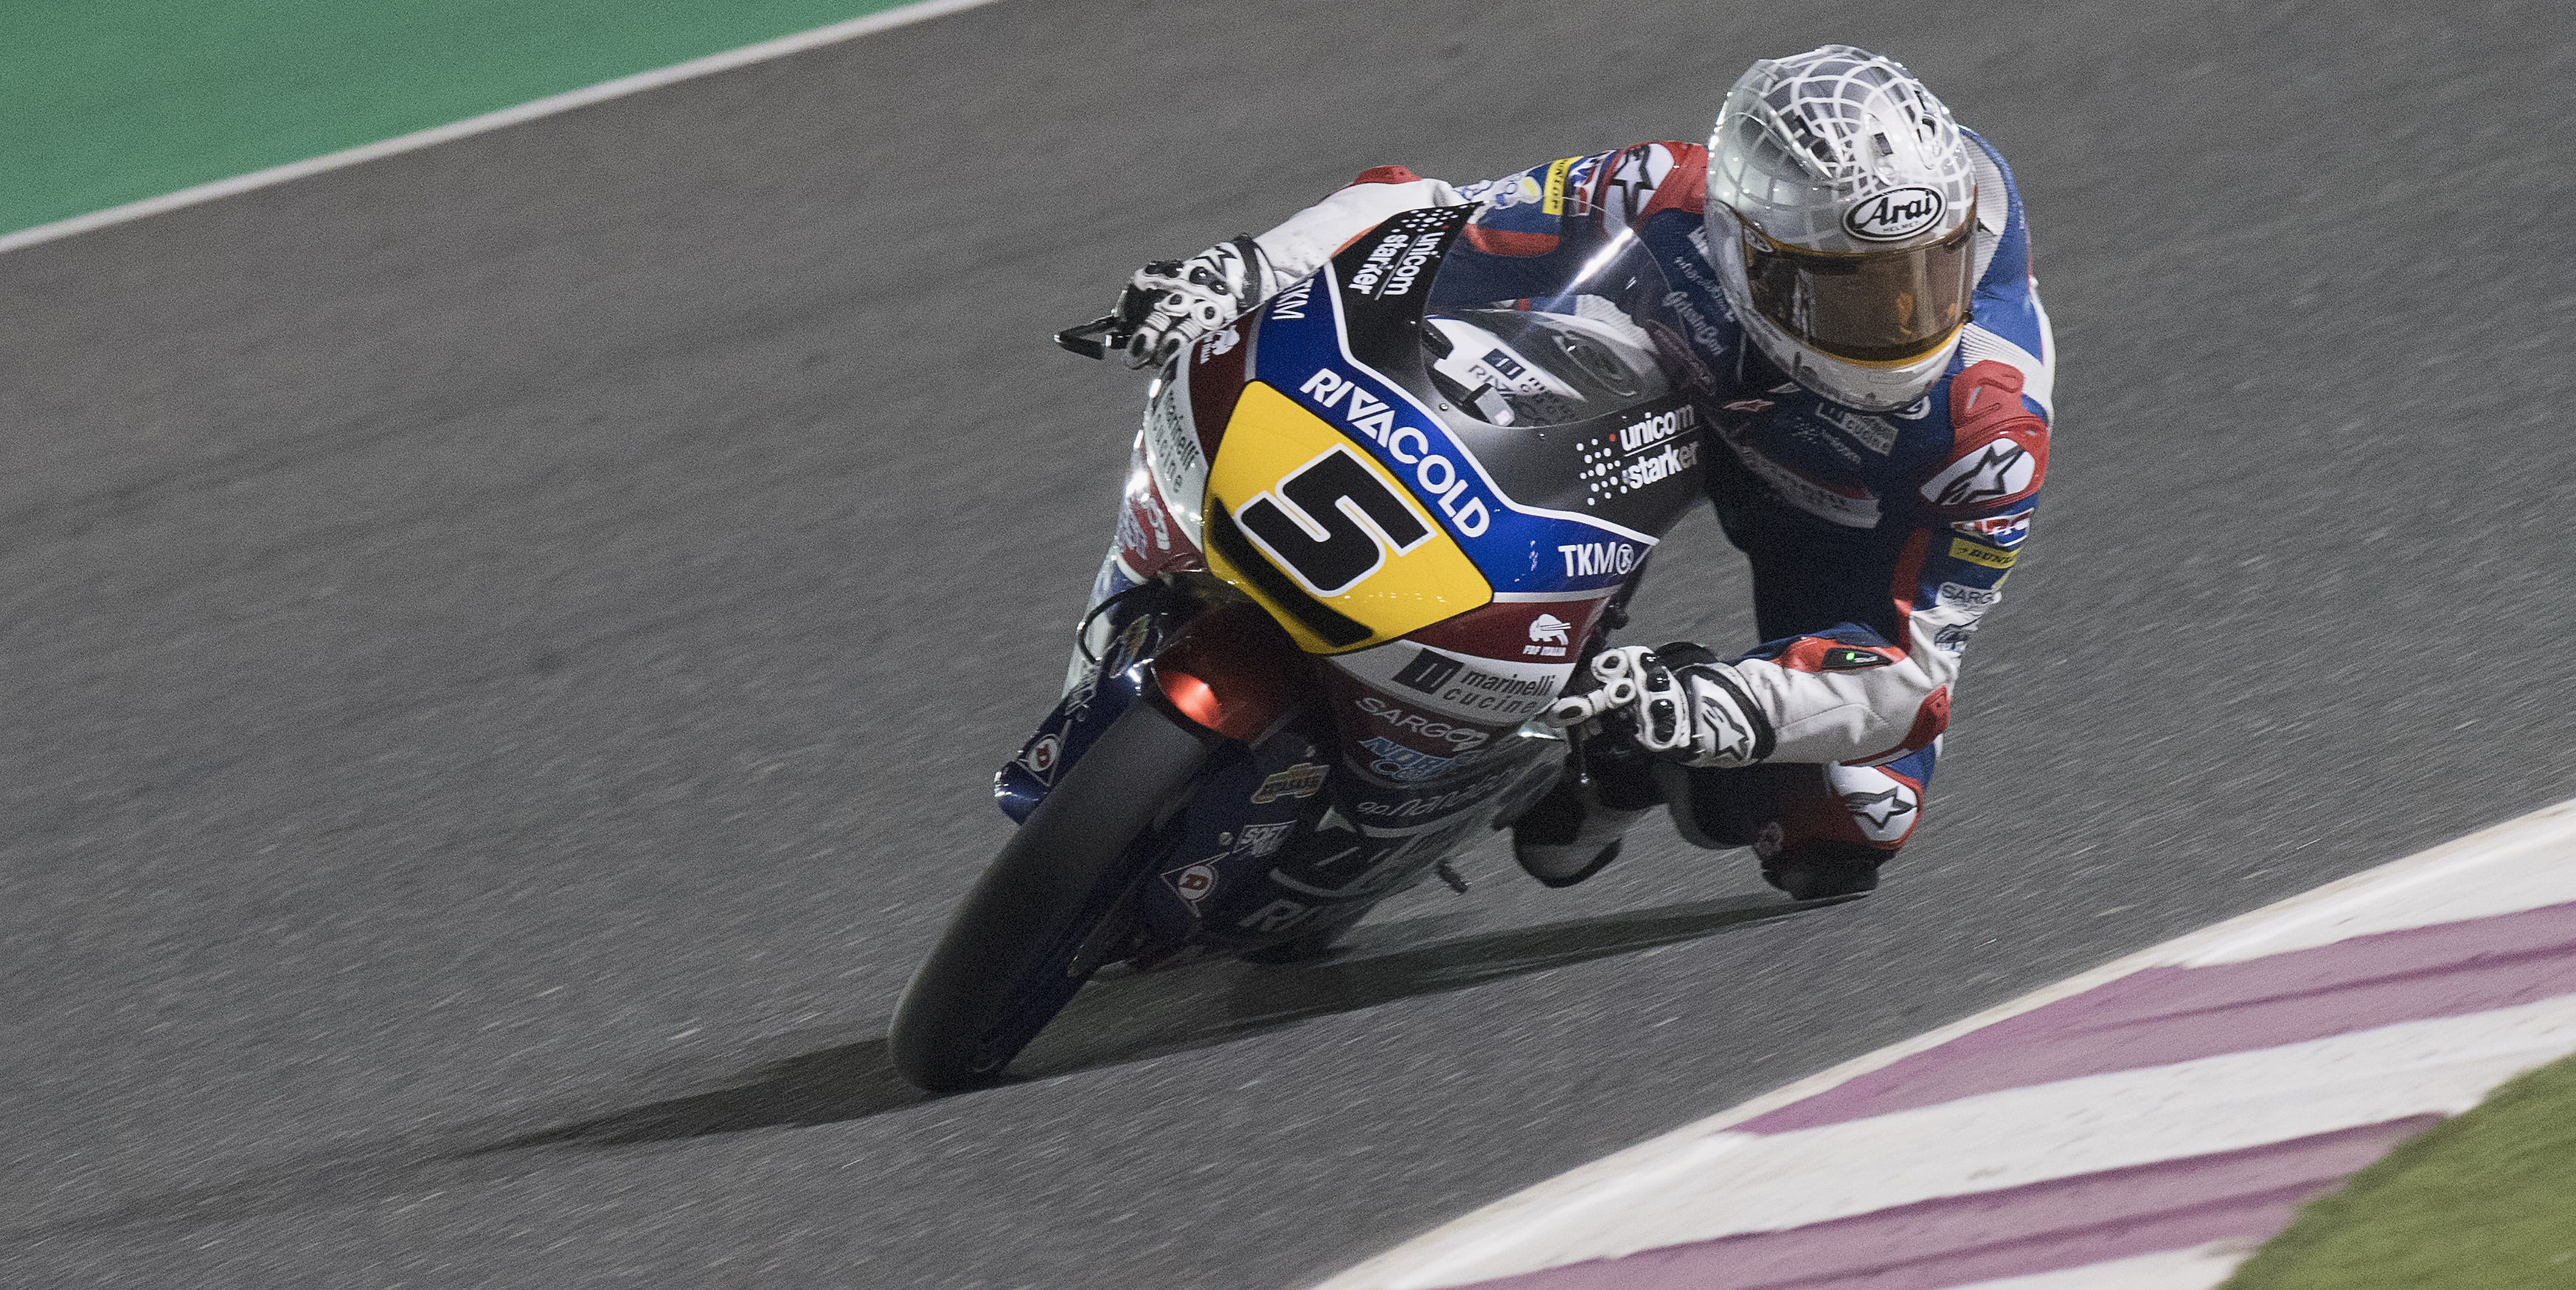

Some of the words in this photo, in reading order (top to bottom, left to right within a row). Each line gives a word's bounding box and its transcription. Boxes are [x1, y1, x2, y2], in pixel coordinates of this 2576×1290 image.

[1854, 190, 1932, 229] Arai
[1348, 233, 1409, 295] starker
[1384, 231, 1445, 295] unicom
[1271, 278, 1315, 320] TKM
[1619, 404, 1696, 451] unicom
[1299, 367, 1490, 538] RIVACOLD
[1628, 443, 1698, 490] starker
[1234, 443, 1438, 597] 5
[1942, 584, 1995, 605] SARG
[1443, 688, 1539, 714] cucine
[1460, 670, 1556, 696] marinelli
